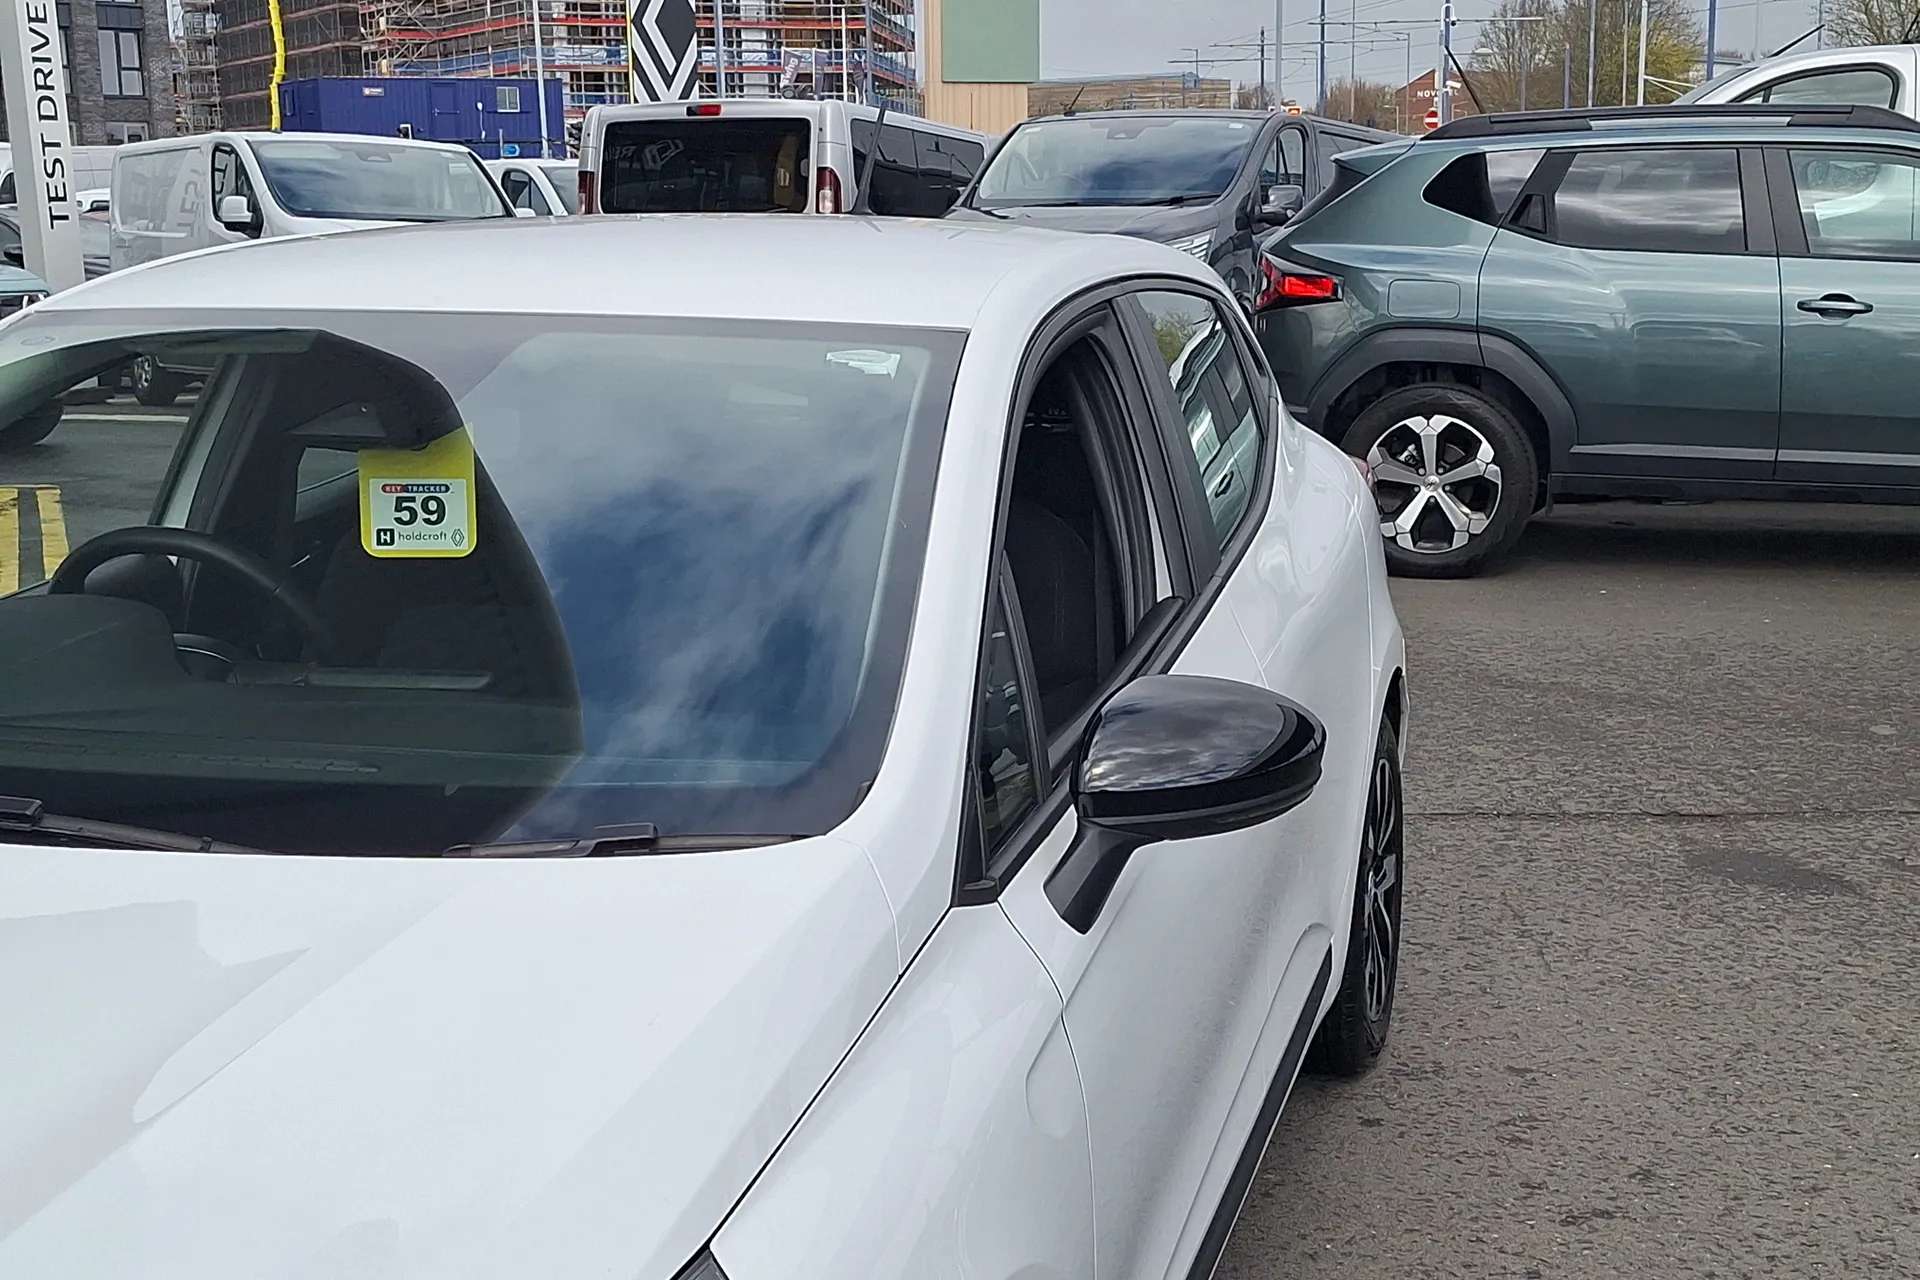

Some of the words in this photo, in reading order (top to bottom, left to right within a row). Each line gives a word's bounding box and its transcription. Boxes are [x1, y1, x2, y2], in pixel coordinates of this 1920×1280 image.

[25, 2, 59, 122] DRIVE
[40, 132, 70, 230] TEST
[393, 495, 447, 526] 59
[398, 530, 447, 541] holdcroft
